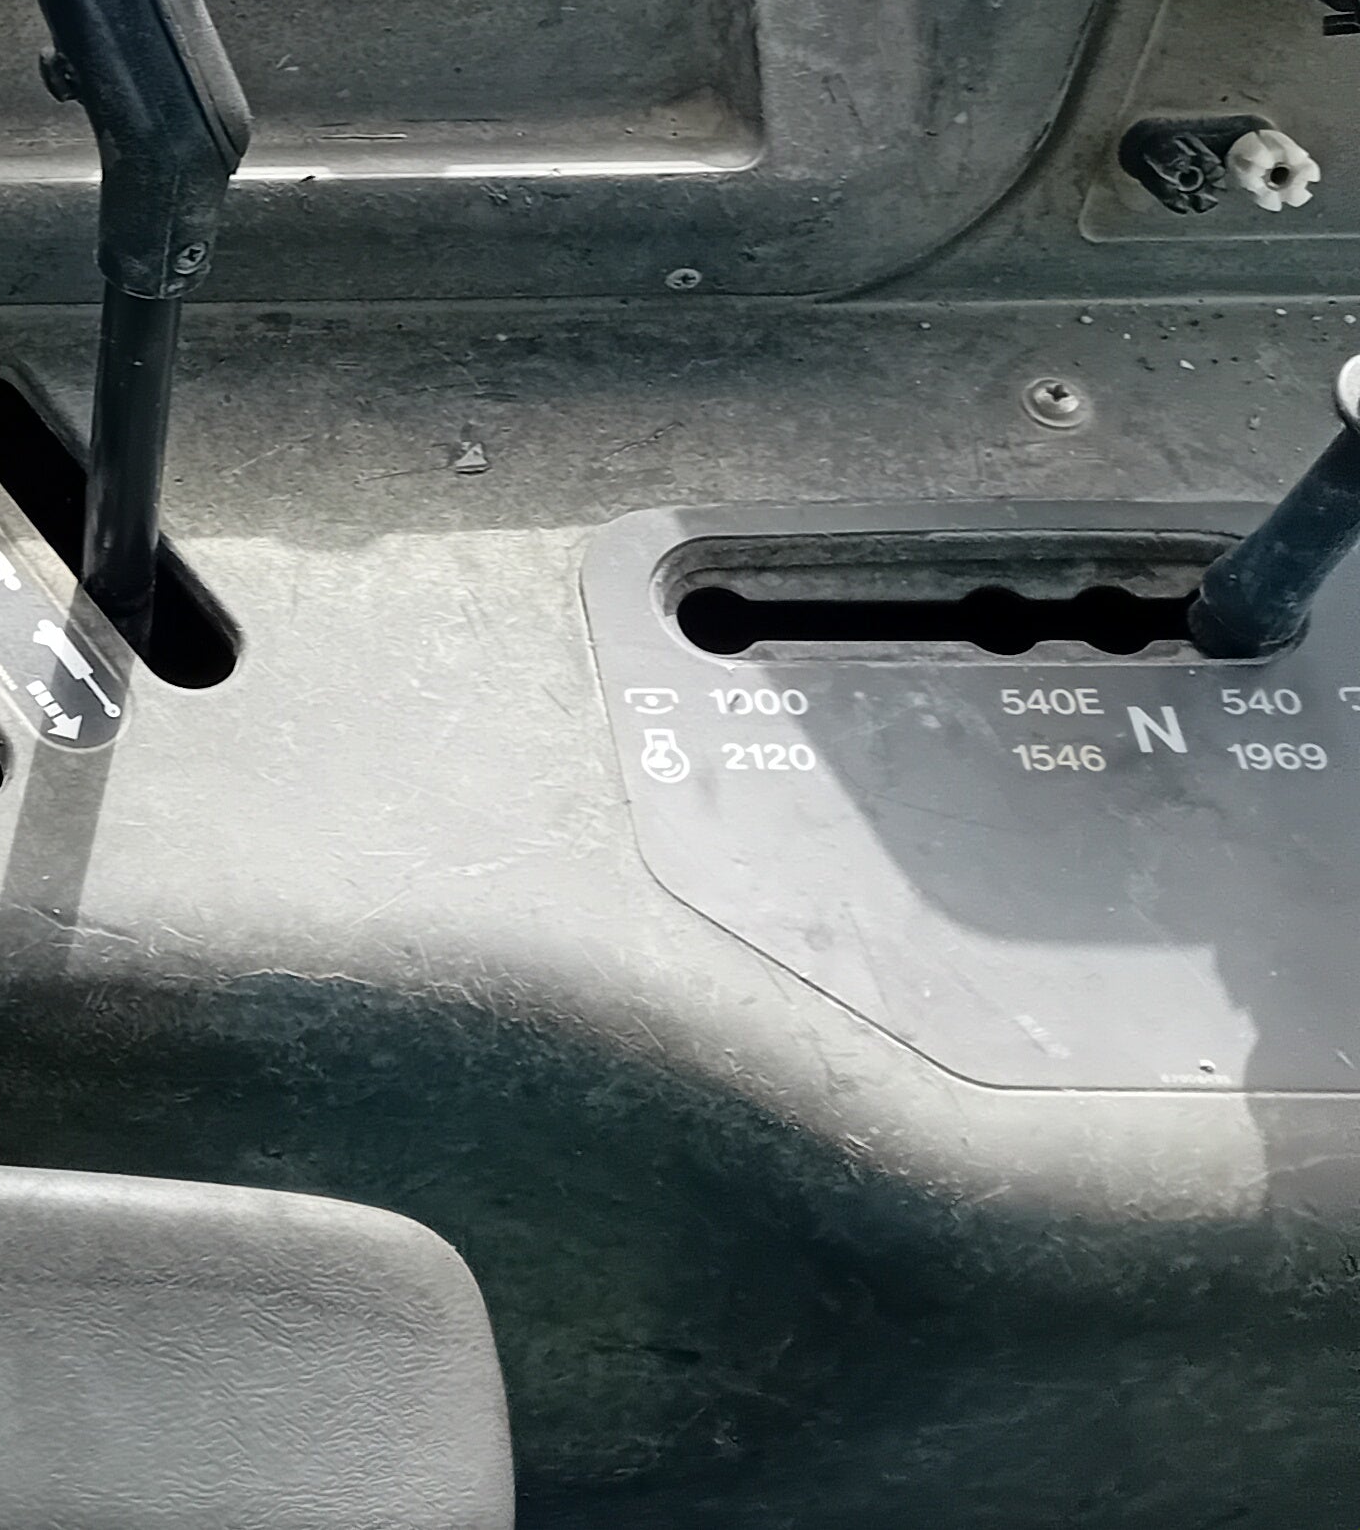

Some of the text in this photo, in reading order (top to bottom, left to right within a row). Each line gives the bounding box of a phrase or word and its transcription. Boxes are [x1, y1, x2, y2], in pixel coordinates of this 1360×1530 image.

[708, 688, 1302, 717] 1000 540E 540
[1127, 707, 1188, 754] N
[720, 743, 1328, 772] 2120 1546 1969
